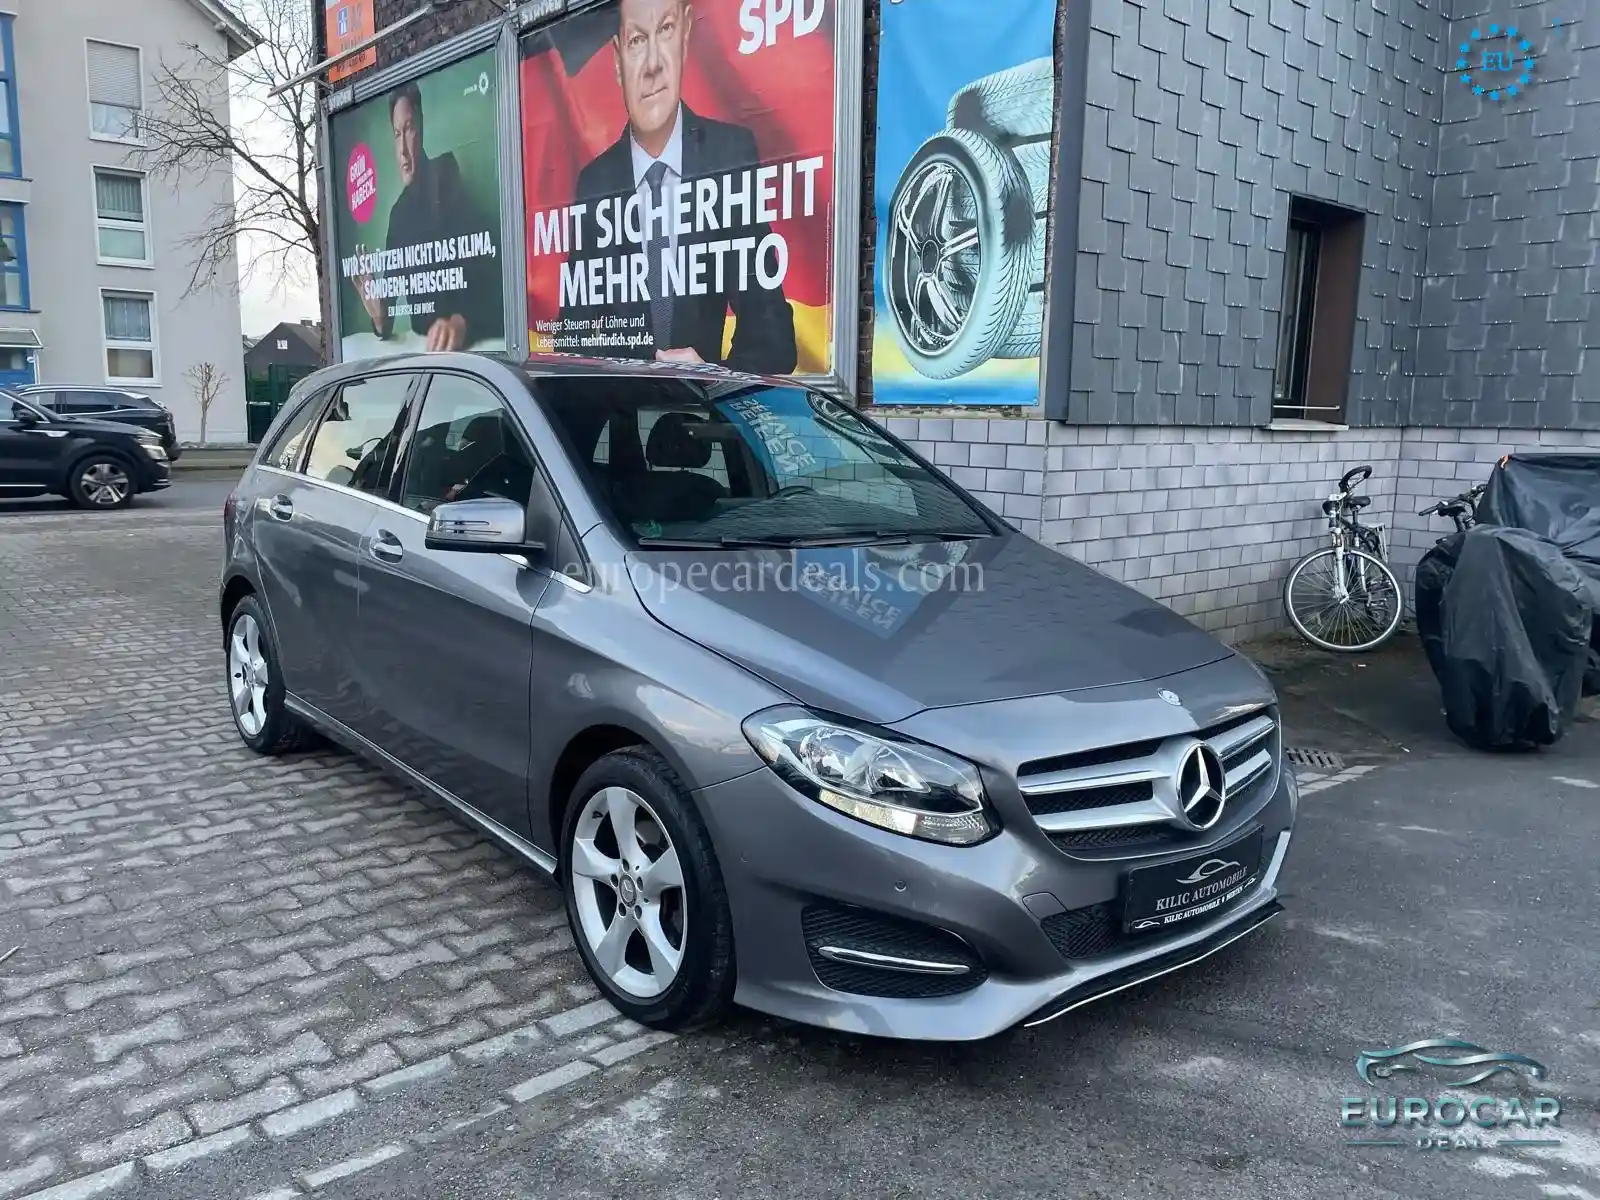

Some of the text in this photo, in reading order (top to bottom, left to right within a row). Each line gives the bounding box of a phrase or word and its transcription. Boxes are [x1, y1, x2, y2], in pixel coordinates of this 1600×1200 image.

[738, 0, 826, 55] SPD
[533, 156, 824, 256] MIT SICHERHEIT
[341, 230, 497, 278] WIR SCHÜTZEN NICHT DAS KLIMA,
[559, 232, 789, 308] MEHR NETTO
[364, 266, 468, 301] SONDERN: MENSCHEN.
[535, 313, 645, 335] Weniger Steuern auf Löhne und
[536, 331, 654, 350] Lebensmittel: mehrfürdich.spd.de
[1155, 893, 1190, 912] KILIC
[1191, 866, 1248, 903] AUTOMOBILE
[1163, 912, 1184, 924] KILIC
